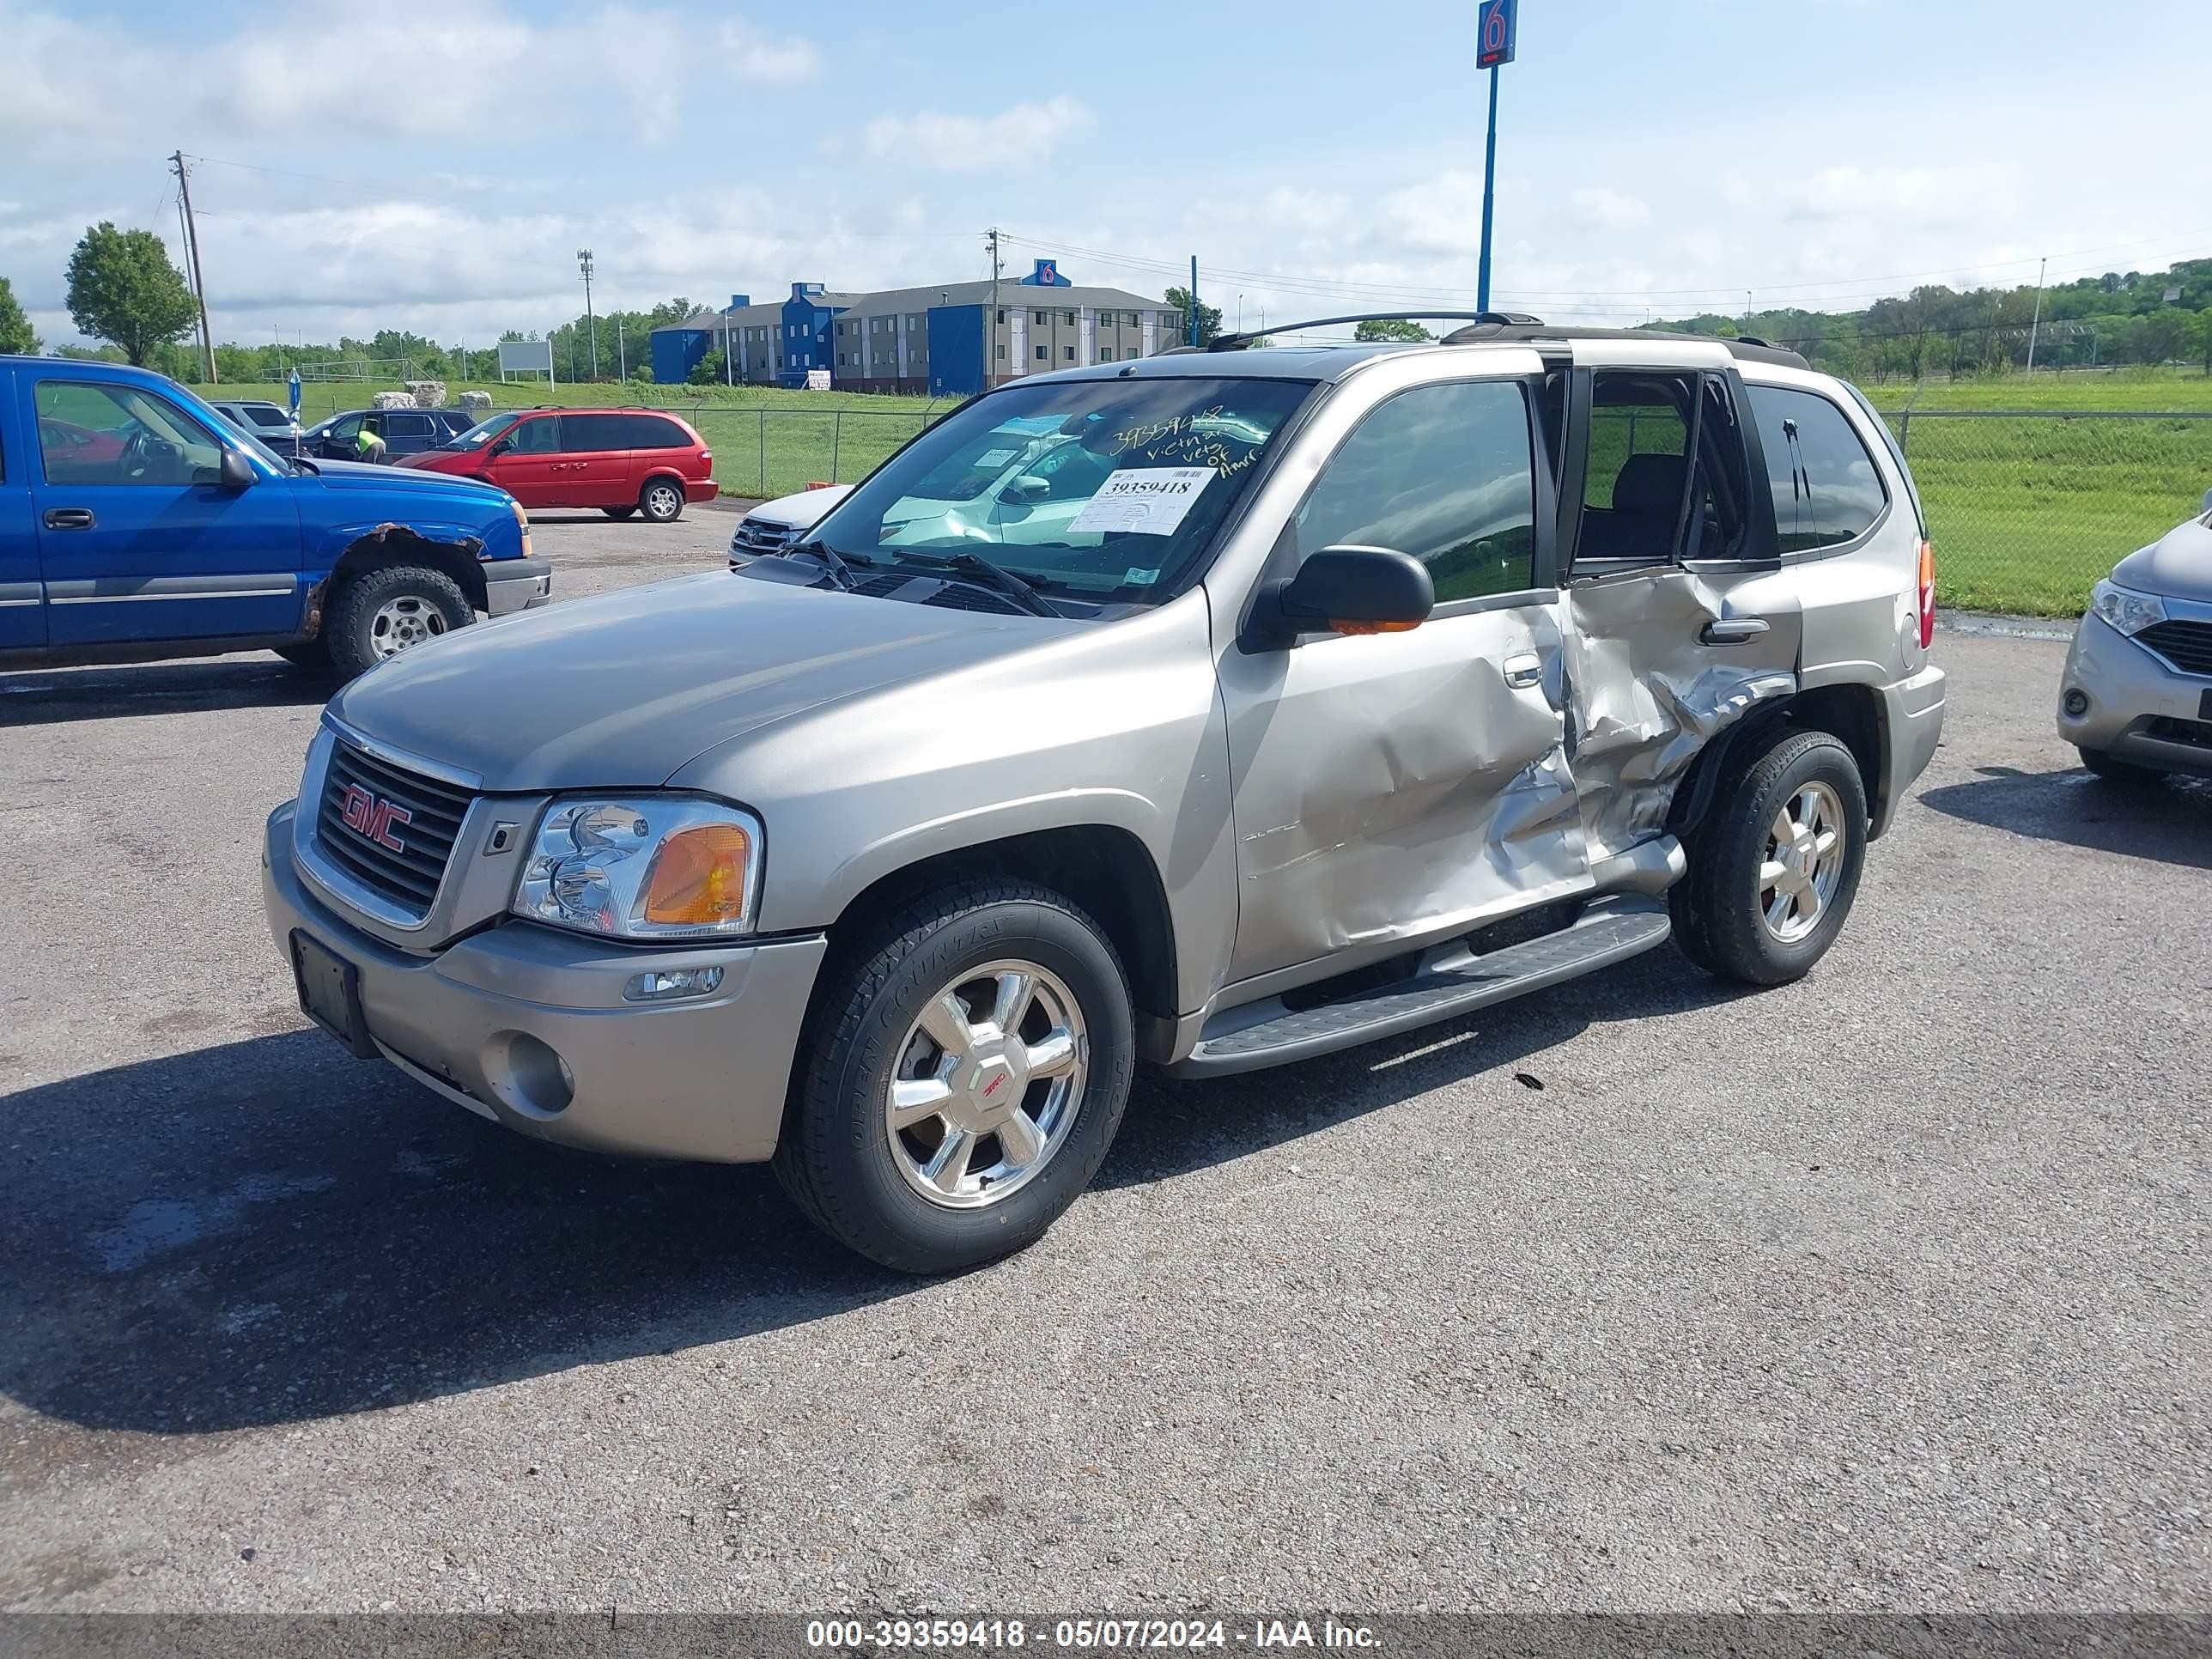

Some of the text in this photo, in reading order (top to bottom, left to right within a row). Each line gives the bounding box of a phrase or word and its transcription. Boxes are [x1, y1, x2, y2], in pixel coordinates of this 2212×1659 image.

[1483, 0, 1505, 52] 6
[1043, 264, 1054, 283] 6
[1105, 481, 1192, 495] 39359418
[343, 782, 412, 854] GMC
